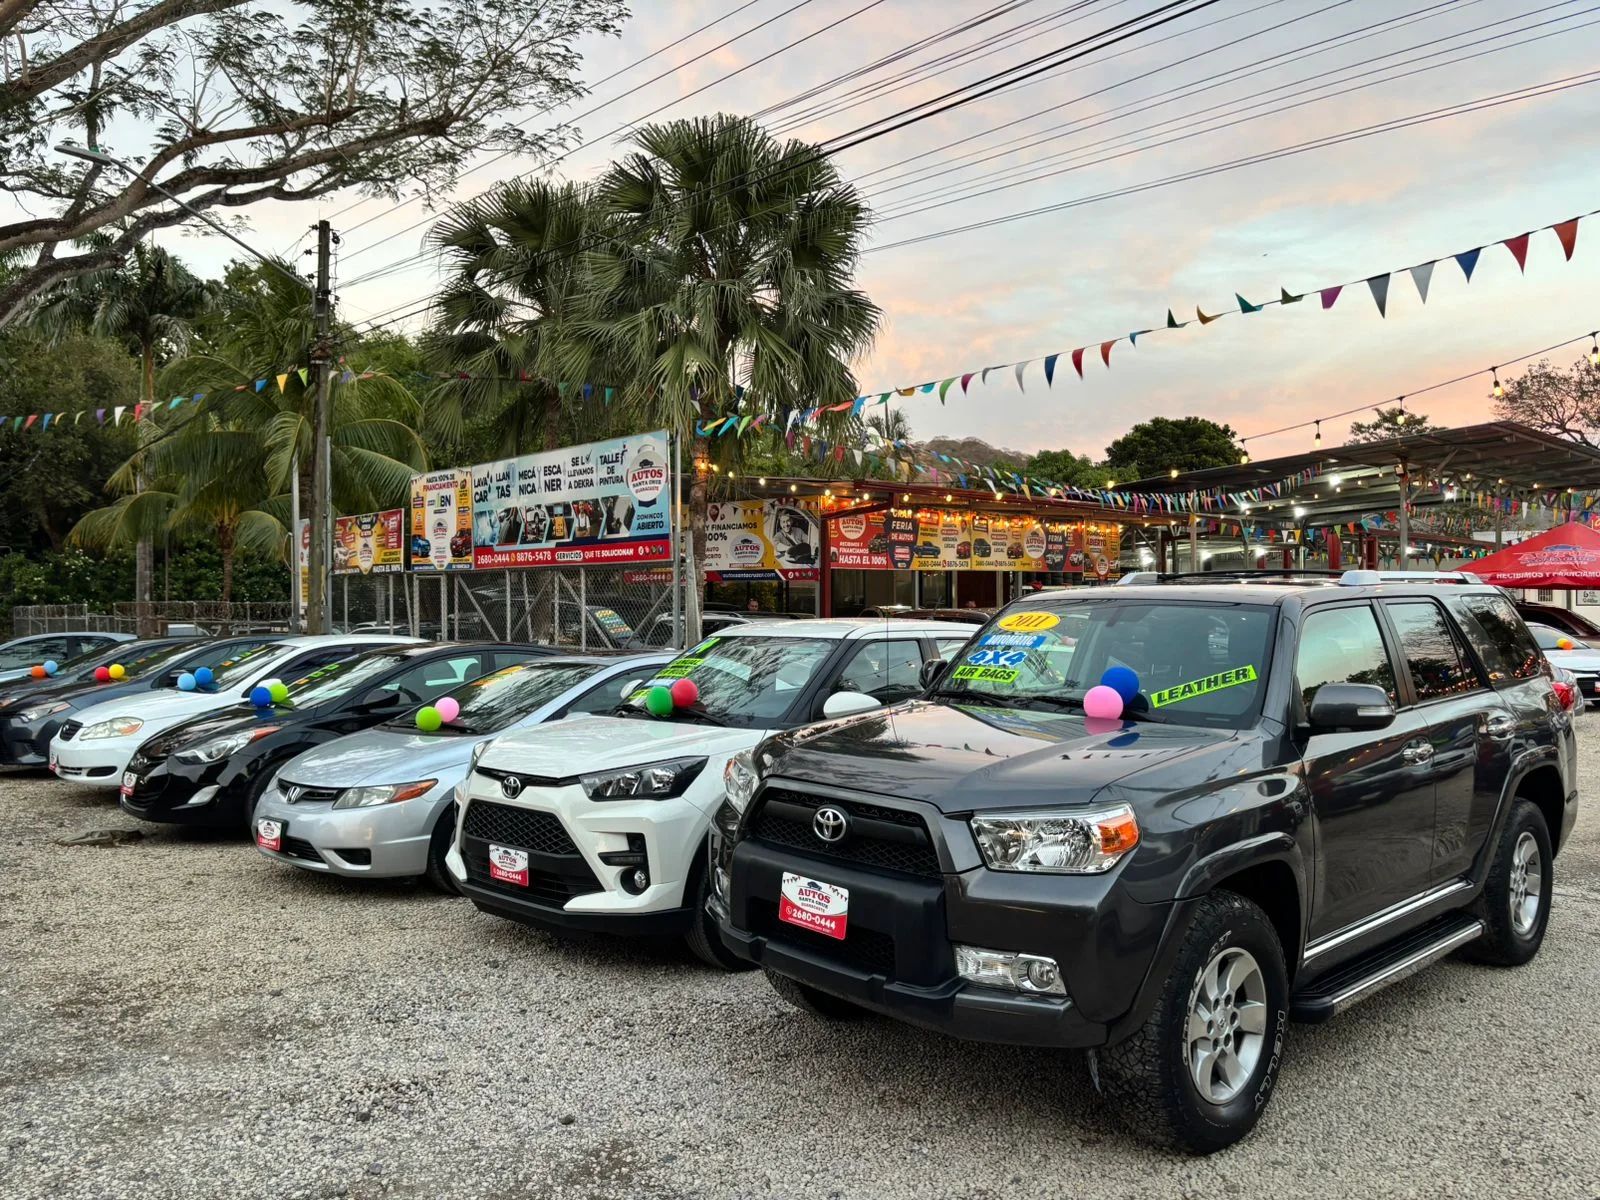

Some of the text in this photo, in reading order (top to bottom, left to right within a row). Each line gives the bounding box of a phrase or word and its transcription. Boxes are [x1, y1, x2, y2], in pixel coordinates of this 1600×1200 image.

[571, 456, 580, 467] SE
[518, 465, 536, 481] MECÁ
[544, 464, 562, 476] ESCA
[567, 466, 594, 478] LLEVAMOS
[606, 465, 615, 475] DE
[631, 468, 663, 483] AUTOS
[473, 476, 488, 488] LAVA
[495, 471, 511, 483] LLAN
[599, 475, 625, 486] PINTURA
[423, 481, 458, 492] FINANCIAMIENTO
[518, 482, 537, 496] NICA
[544, 478, 562, 493] NER
[567, 478, 594, 490] A DEKRA
[473, 490, 489, 503] CAR
[495, 484, 511, 500] TAS
[636, 512, 664, 520] DOMINGOS
[841, 518, 864, 526] AUTOS
[636, 520, 665, 531] ABIERTO
[711, 522, 757, 530] FINANCIAMOS
[891, 521, 913, 531] FERIA
[898, 533, 914, 541] AUTOS
[734, 544, 760, 552] AUTOS
[477, 553, 510, 565] 2680-0444
[516, 551, 552, 562] 8876-5478
[556, 551, 583, 561] SERVICIOS
[584, 551, 594, 559] QUE
[595, 550, 600, 558] TE
[601, 548, 634, 557] SOLUCIONAN
[839, 555, 887, 566] HASTA EL 100%
[1004, 615, 1051, 628] 2011
[985, 634, 1037, 646] AUTOMATIC
[955, 667, 1016, 681] AIR BAGS
[1157, 667, 1249, 704] LEATHER
[798, 887, 831, 904] AUTOS
[798, 896, 815, 904] SANTA
[792, 908, 837, 930] 2680-0444
[1254, 1009, 1286, 1113] KELLY
